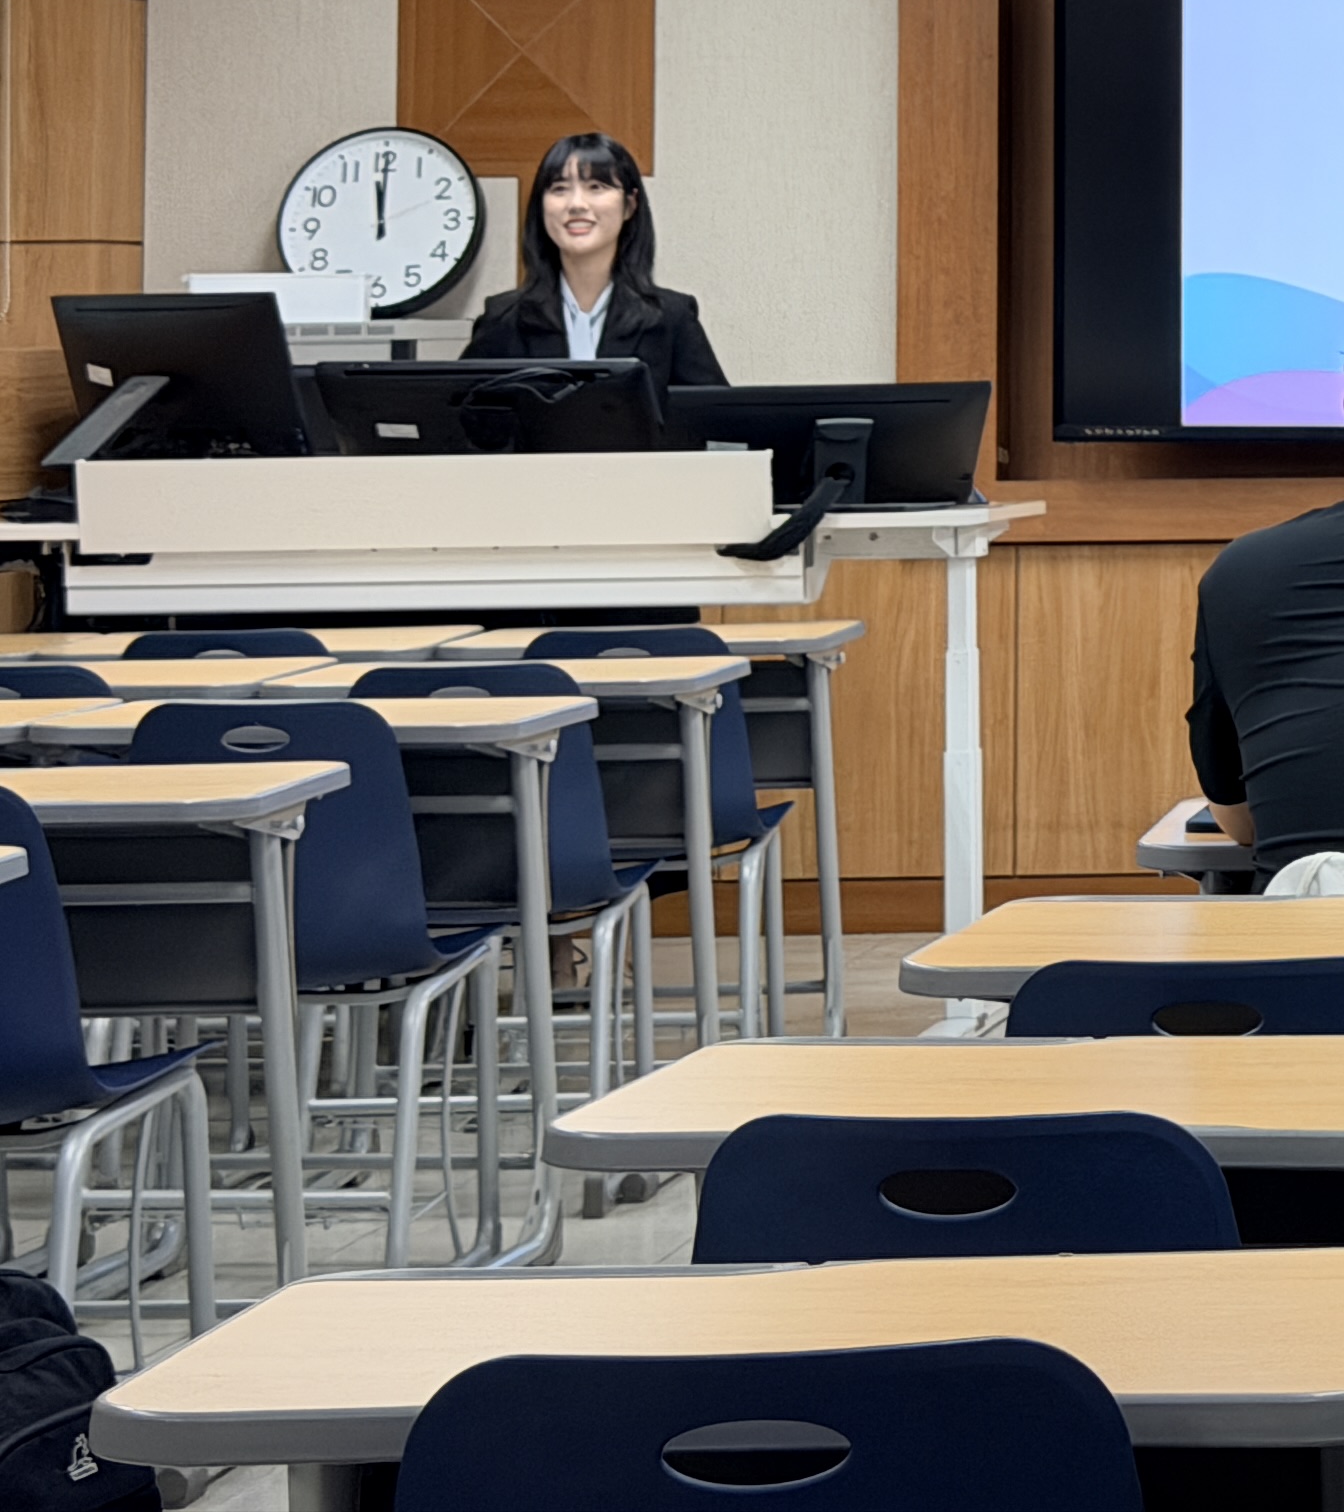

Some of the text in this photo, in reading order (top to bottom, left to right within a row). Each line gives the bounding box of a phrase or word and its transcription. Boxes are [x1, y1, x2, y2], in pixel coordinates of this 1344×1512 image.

[341, 160, 360, 183] 11
[374, 151, 397, 173] 12
[417, 156, 423, 178] 1
[311, 185, 337, 208] 10
[434, 177, 452, 200] 2
[303, 217, 321, 240] 9
[443, 208, 461, 231] 3
[310, 248, 328, 271] 8
[430, 241, 448, 262] 4
[370, 276, 387, 298] 6
[404, 265, 421, 287] 5
